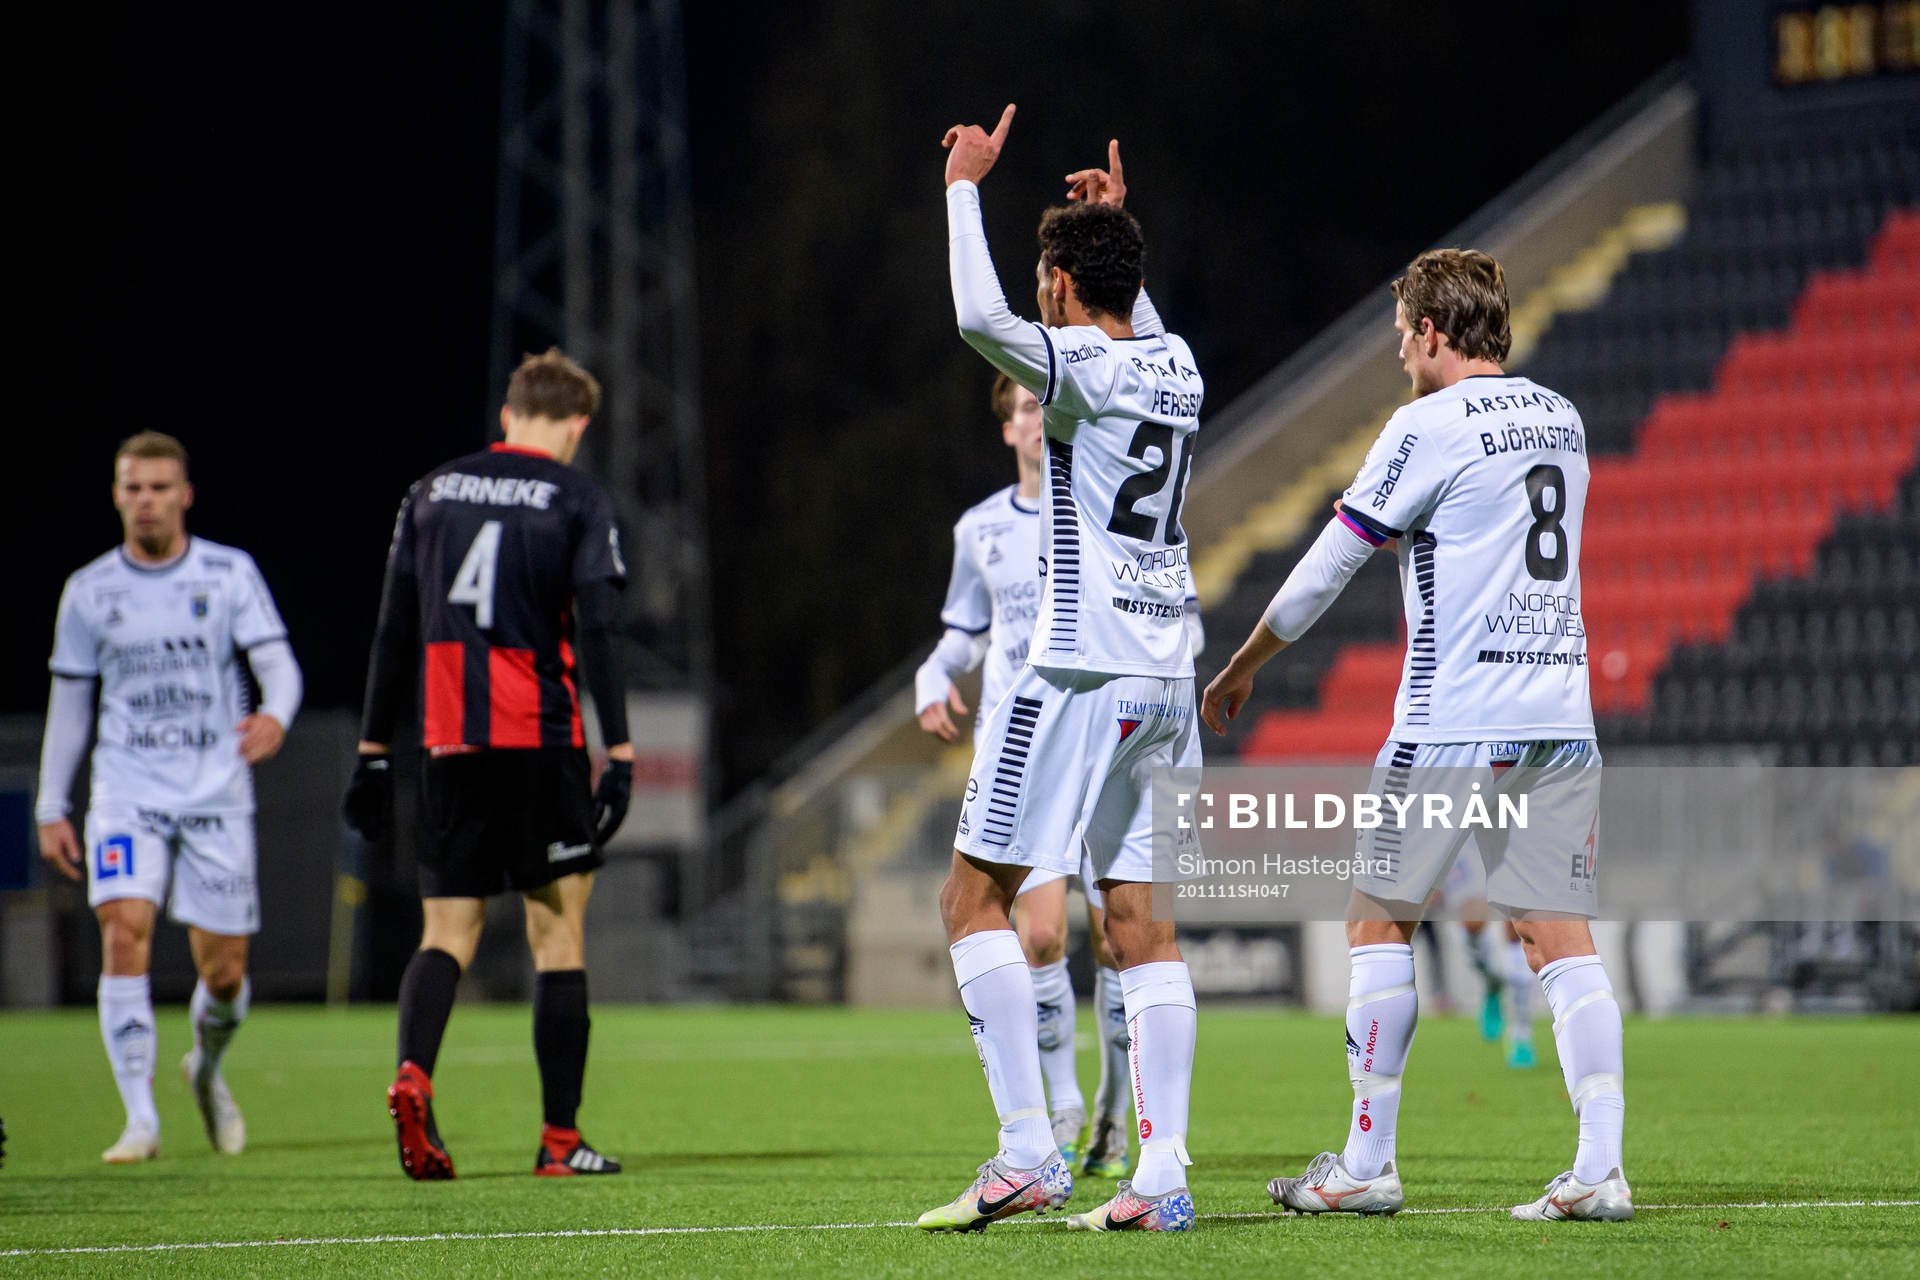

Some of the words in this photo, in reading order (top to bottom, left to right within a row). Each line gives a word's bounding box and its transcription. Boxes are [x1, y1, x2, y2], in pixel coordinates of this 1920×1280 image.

[1152, 389, 1202, 418] PERSSO
[1372, 433, 1418, 511] stadium
[429, 473, 560, 510] SERNEKE
[1525, 464, 1568, 581] 8
[448, 520, 503, 630] 4
[1509, 592, 1579, 615] NORDC
[1485, 614, 1585, 638] WELLNES
[1366, 1019, 1379, 1055] Motor
